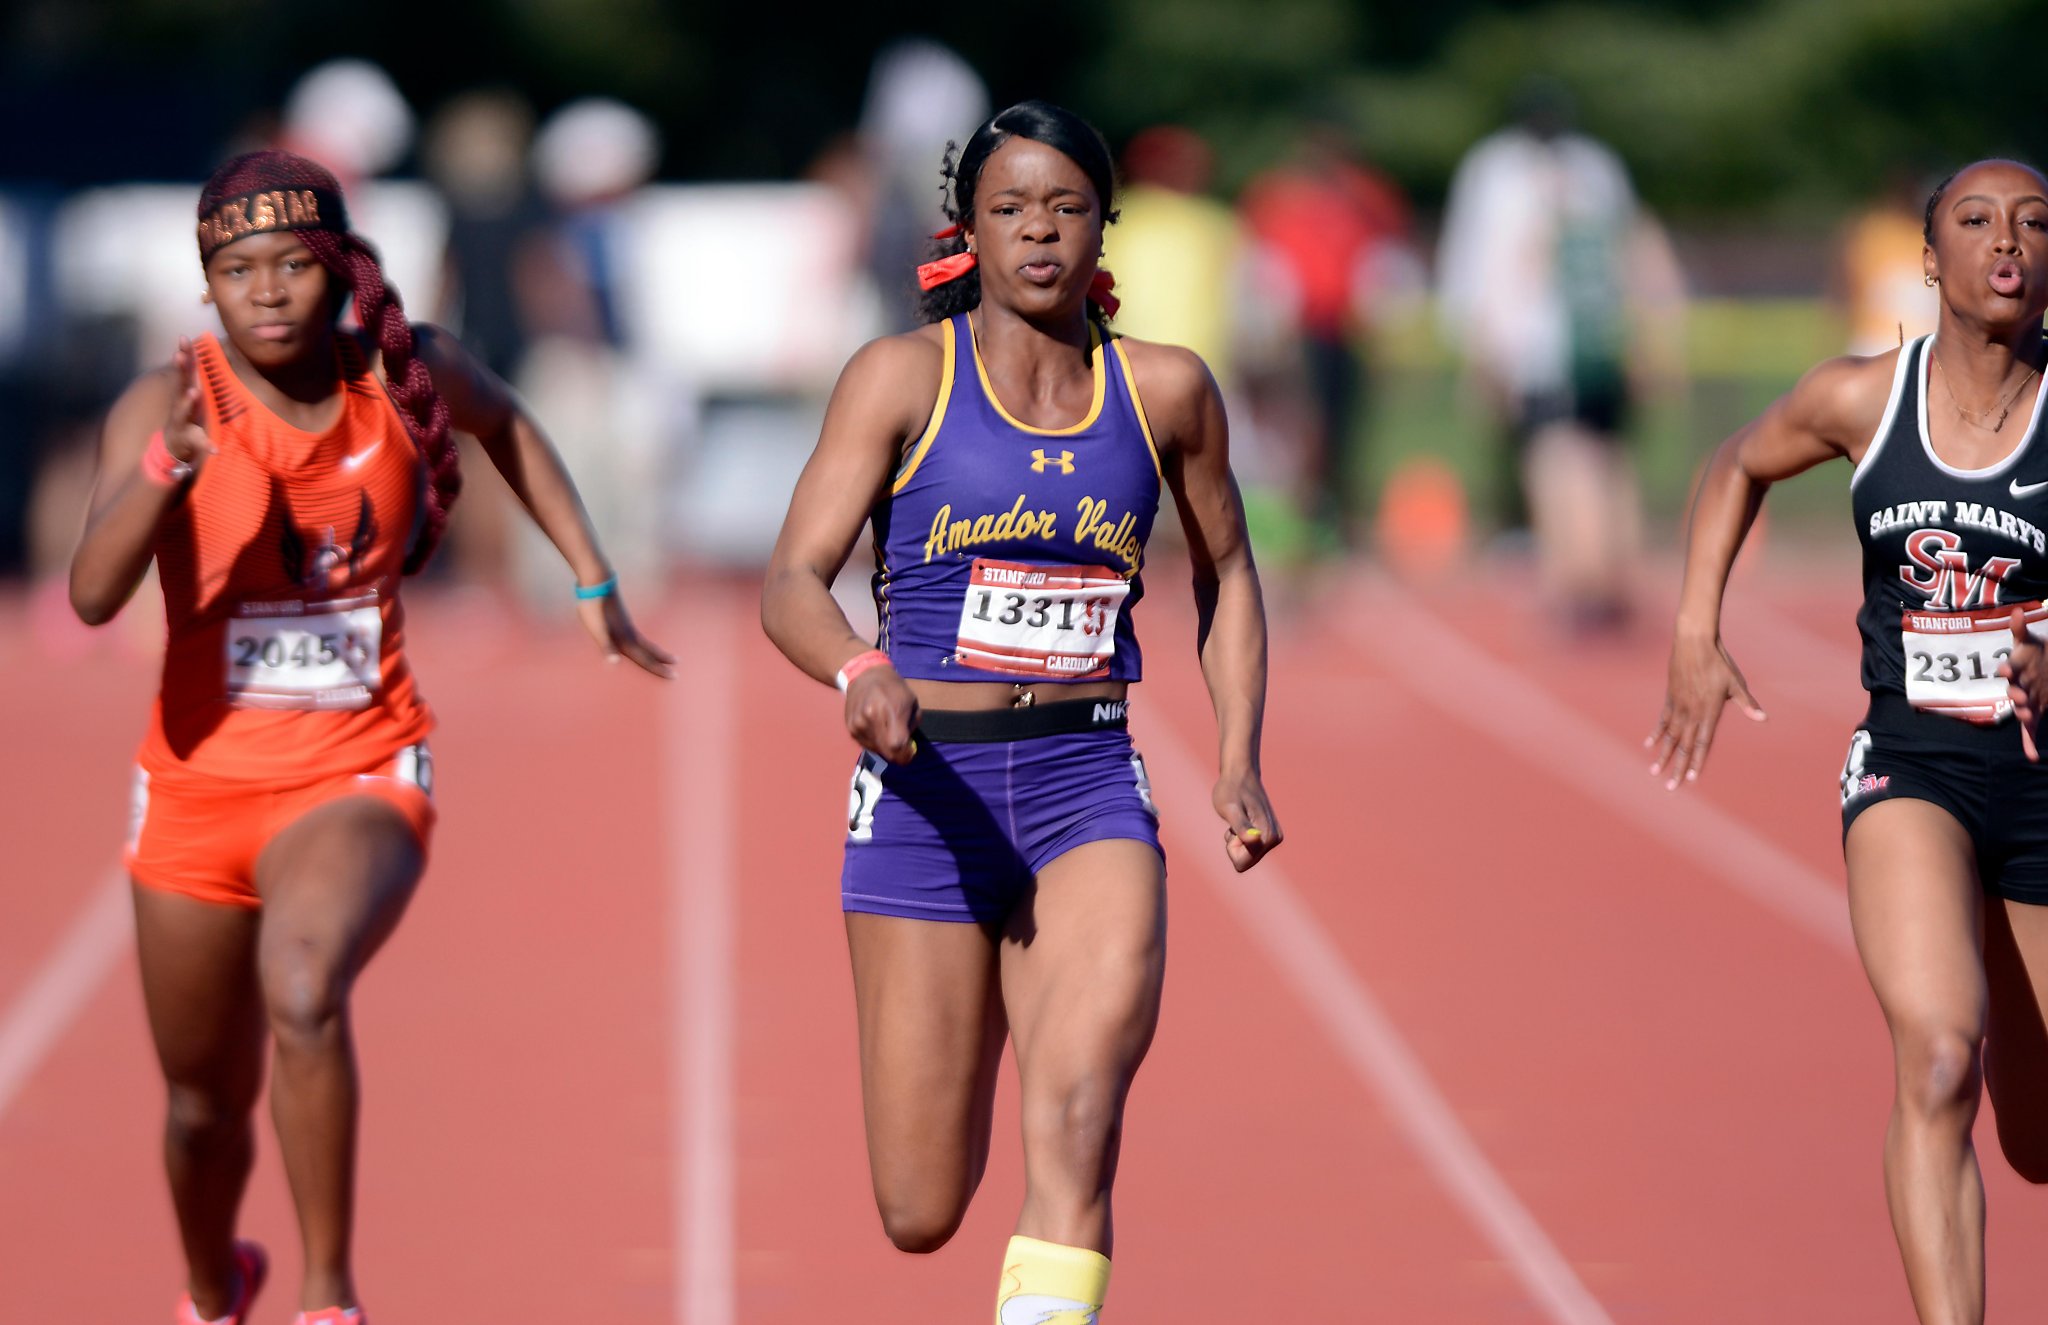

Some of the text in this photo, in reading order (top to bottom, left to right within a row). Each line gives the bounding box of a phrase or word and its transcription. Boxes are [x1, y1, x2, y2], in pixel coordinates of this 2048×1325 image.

[925, 494, 1142, 578] Amador Valley
[1870, 501, 2046, 553] SAINT MARY'S
[983, 567, 1046, 585] STANFORD
[1900, 528, 2021, 609] SM
[972, 590, 1075, 630] 1331
[1912, 616, 1972, 630] STANFORD
[235, 633, 337, 668] 2045
[1092, 701, 1130, 721] NIK
